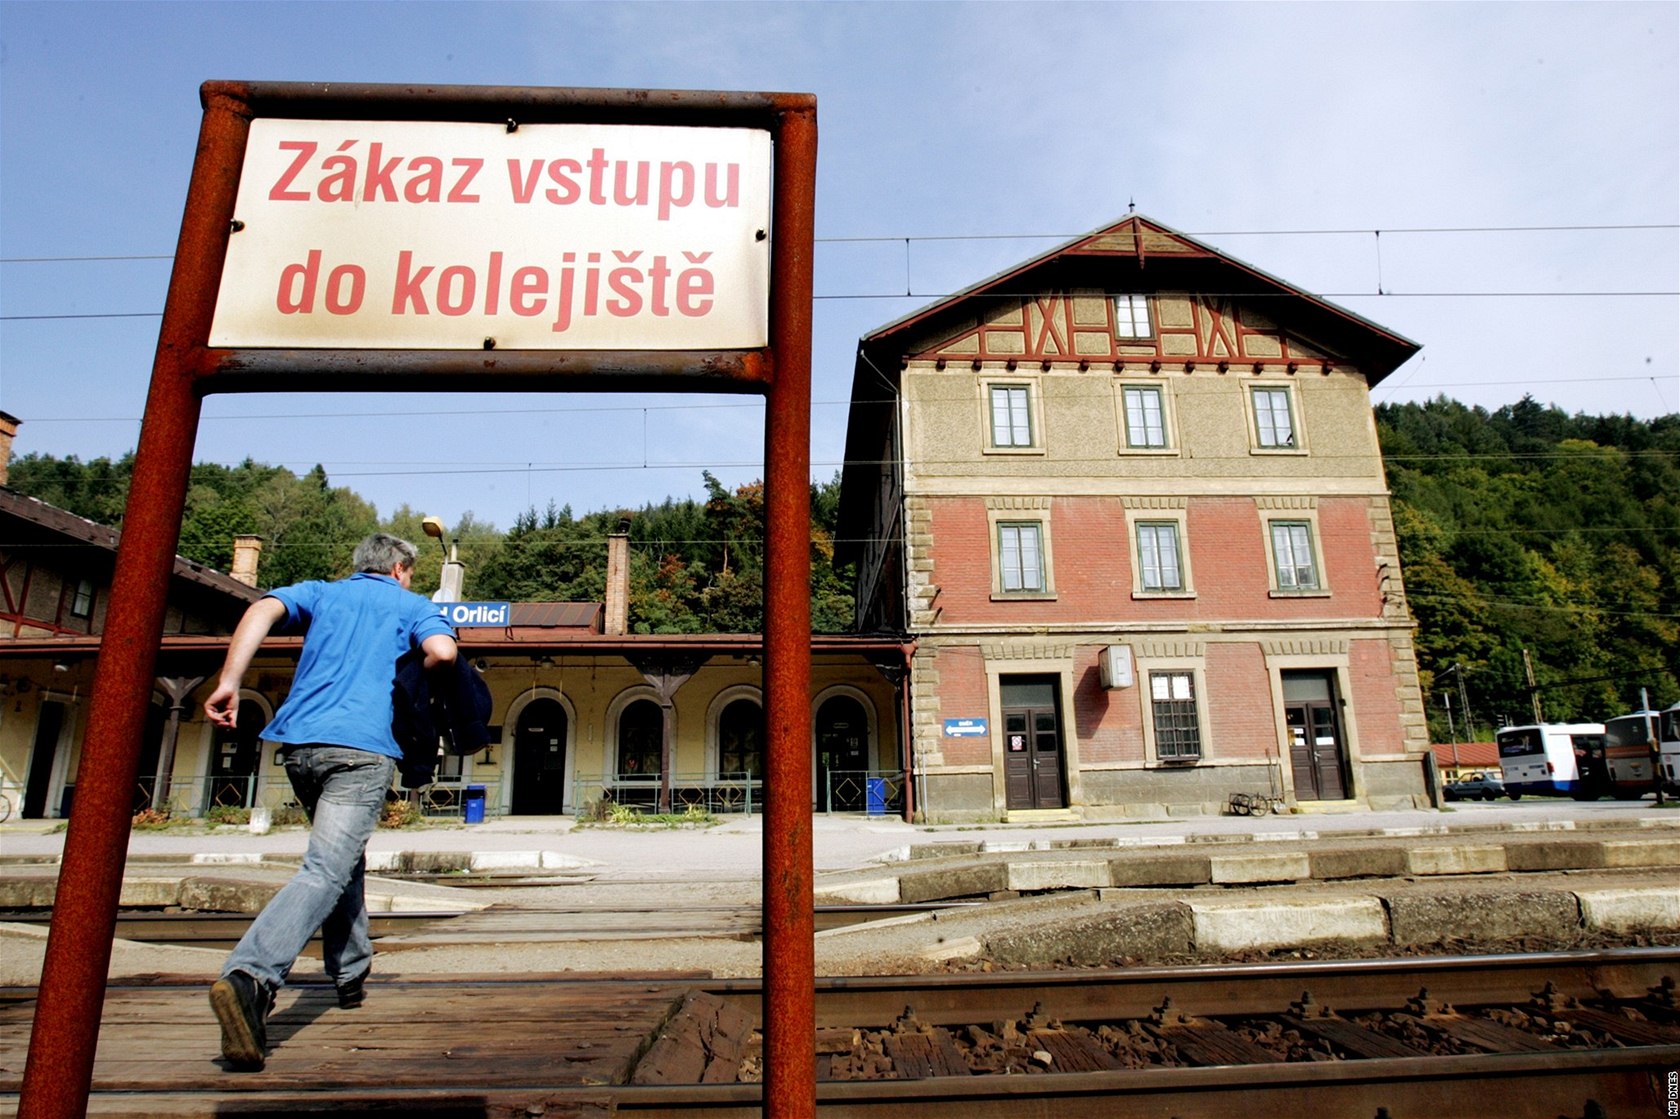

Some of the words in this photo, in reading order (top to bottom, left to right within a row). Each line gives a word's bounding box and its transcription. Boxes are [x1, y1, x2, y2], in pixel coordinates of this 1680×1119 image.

[268, 139, 484, 205] Zákaz
[507, 147, 740, 221] vstupu
[276, 249, 367, 316] do
[391, 250, 714, 332] kolejiště
[452, 605, 508, 623] Orlicí
